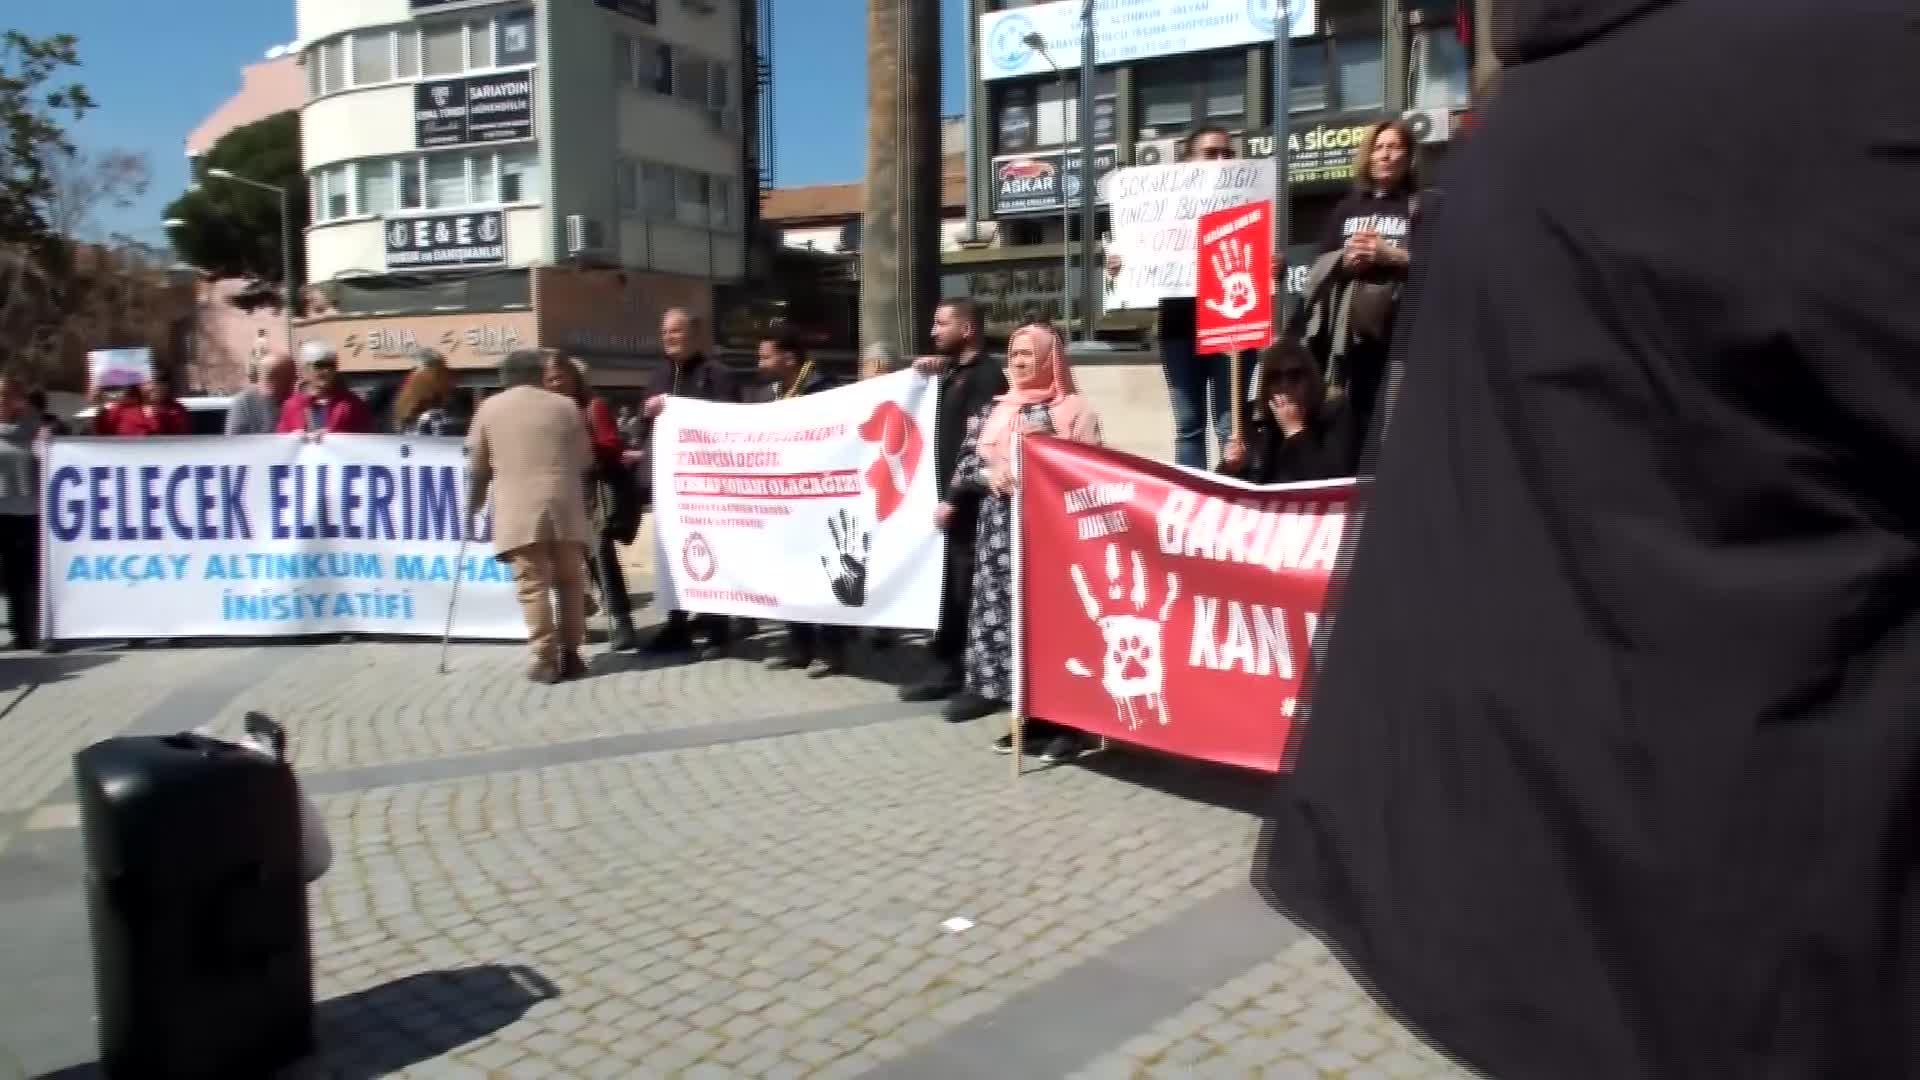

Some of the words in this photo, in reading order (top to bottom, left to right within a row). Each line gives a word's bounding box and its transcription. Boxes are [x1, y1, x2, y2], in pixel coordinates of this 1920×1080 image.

[1248, 134, 1300, 154] TUA
[1304, 125, 1367, 150] SİGOR
[414, 221, 429, 247] E
[456, 218, 472, 245] E
[48, 464, 252, 542] GELECEK
[1157, 488, 1348, 572] BARINA
[65, 552, 191, 587] AKÇAY
[203, 552, 385, 581] ALTINKUM
[1188, 594, 1293, 681] KAN
